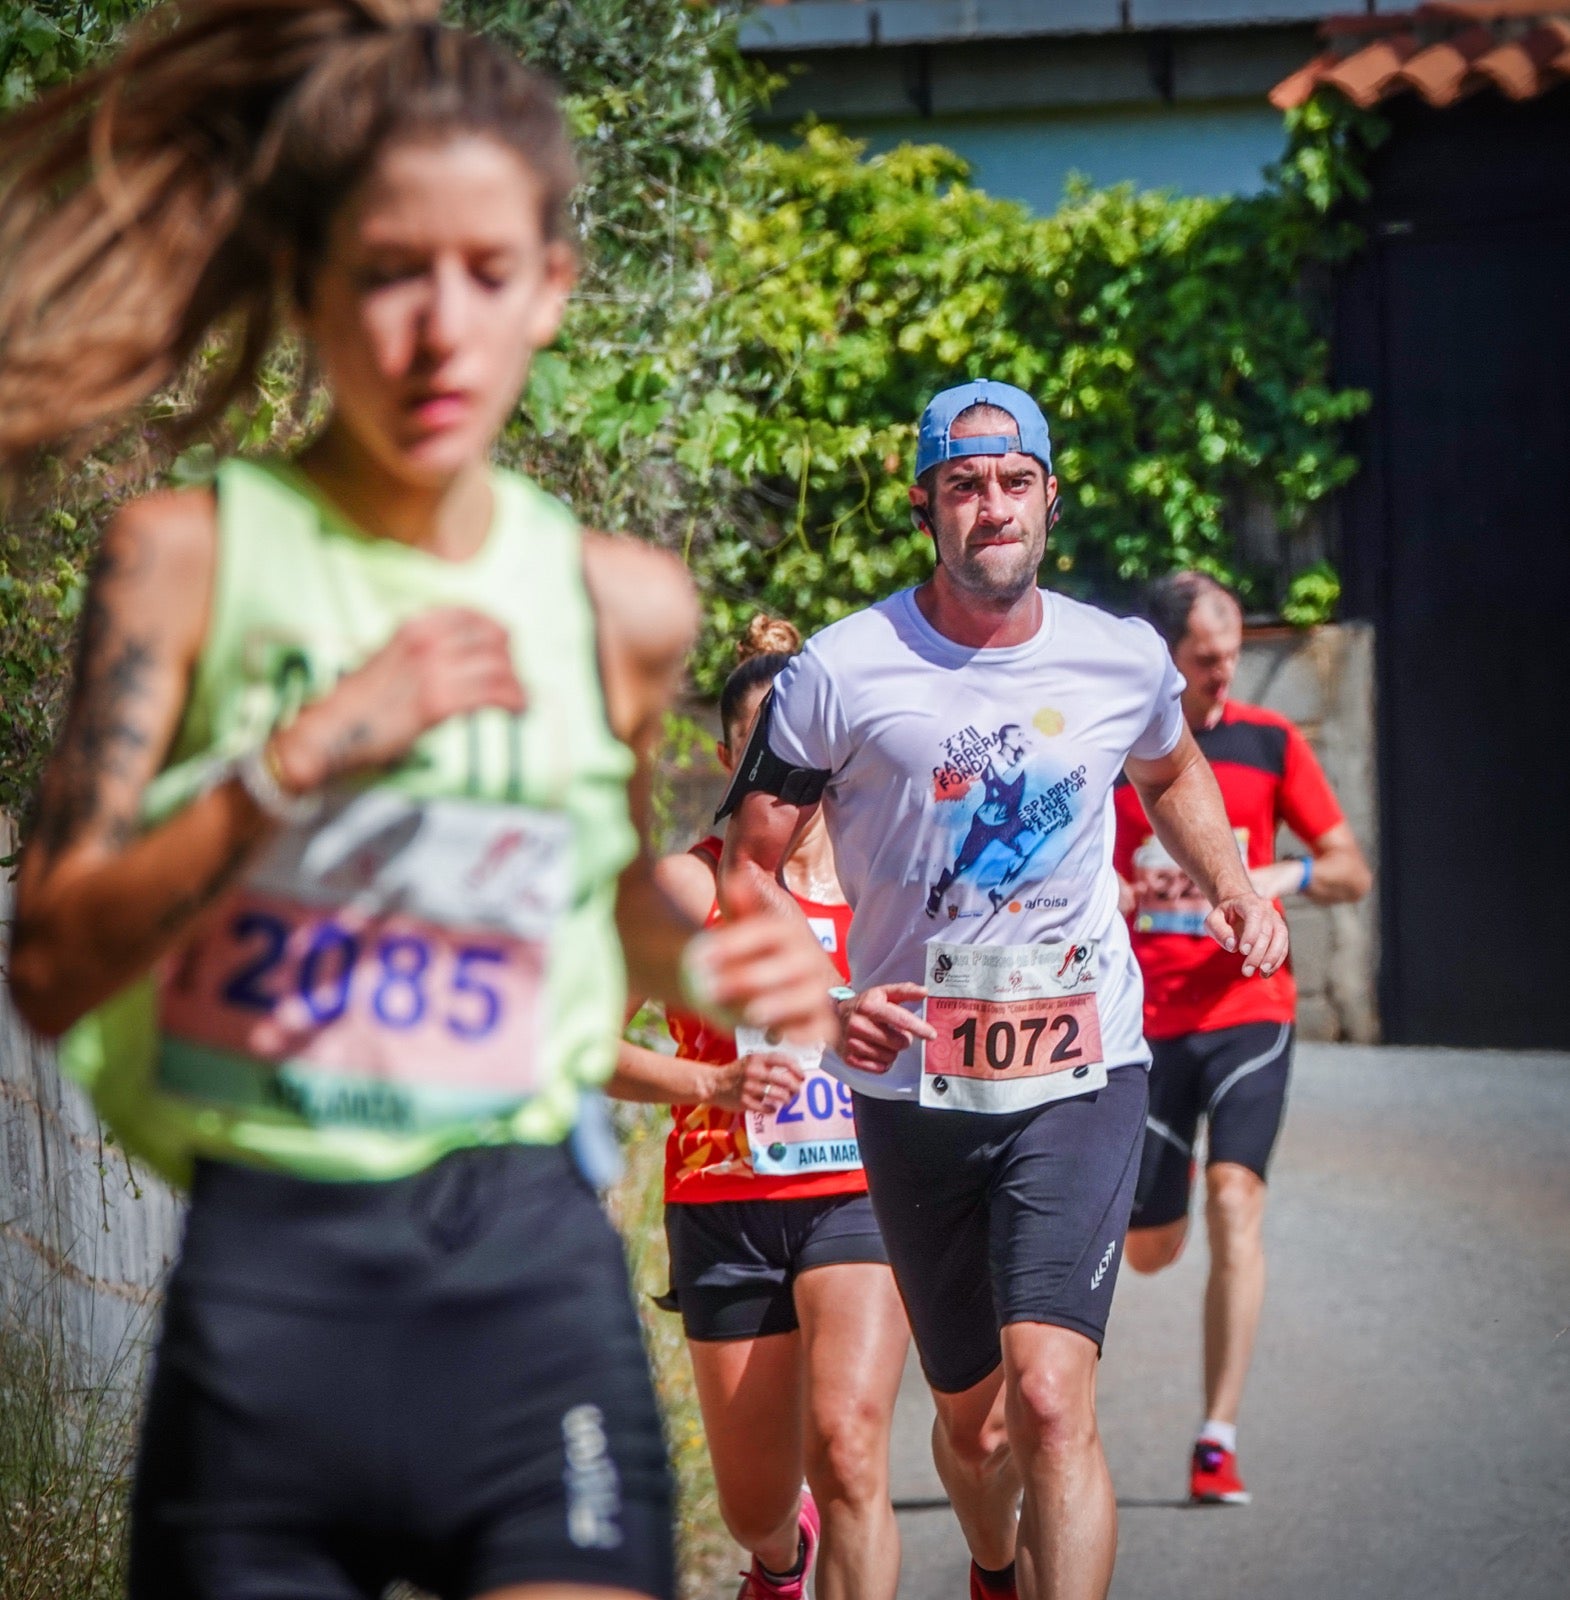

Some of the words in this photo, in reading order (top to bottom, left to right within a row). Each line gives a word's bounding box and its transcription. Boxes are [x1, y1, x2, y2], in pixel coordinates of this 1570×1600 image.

[932, 731, 1001, 777] CARRERA
[939, 754, 991, 791] FONDO
[1018, 765, 1086, 820] ESPARRAGO
[1022, 812, 1040, 830] DE
[1041, 777, 1087, 816] HUETOR
[1029, 803, 1069, 836] TAJAR
[222, 913, 505, 1042] 2085
[952, 1014, 1083, 1070] 1072
[798, 1146, 828, 1166] ANA
